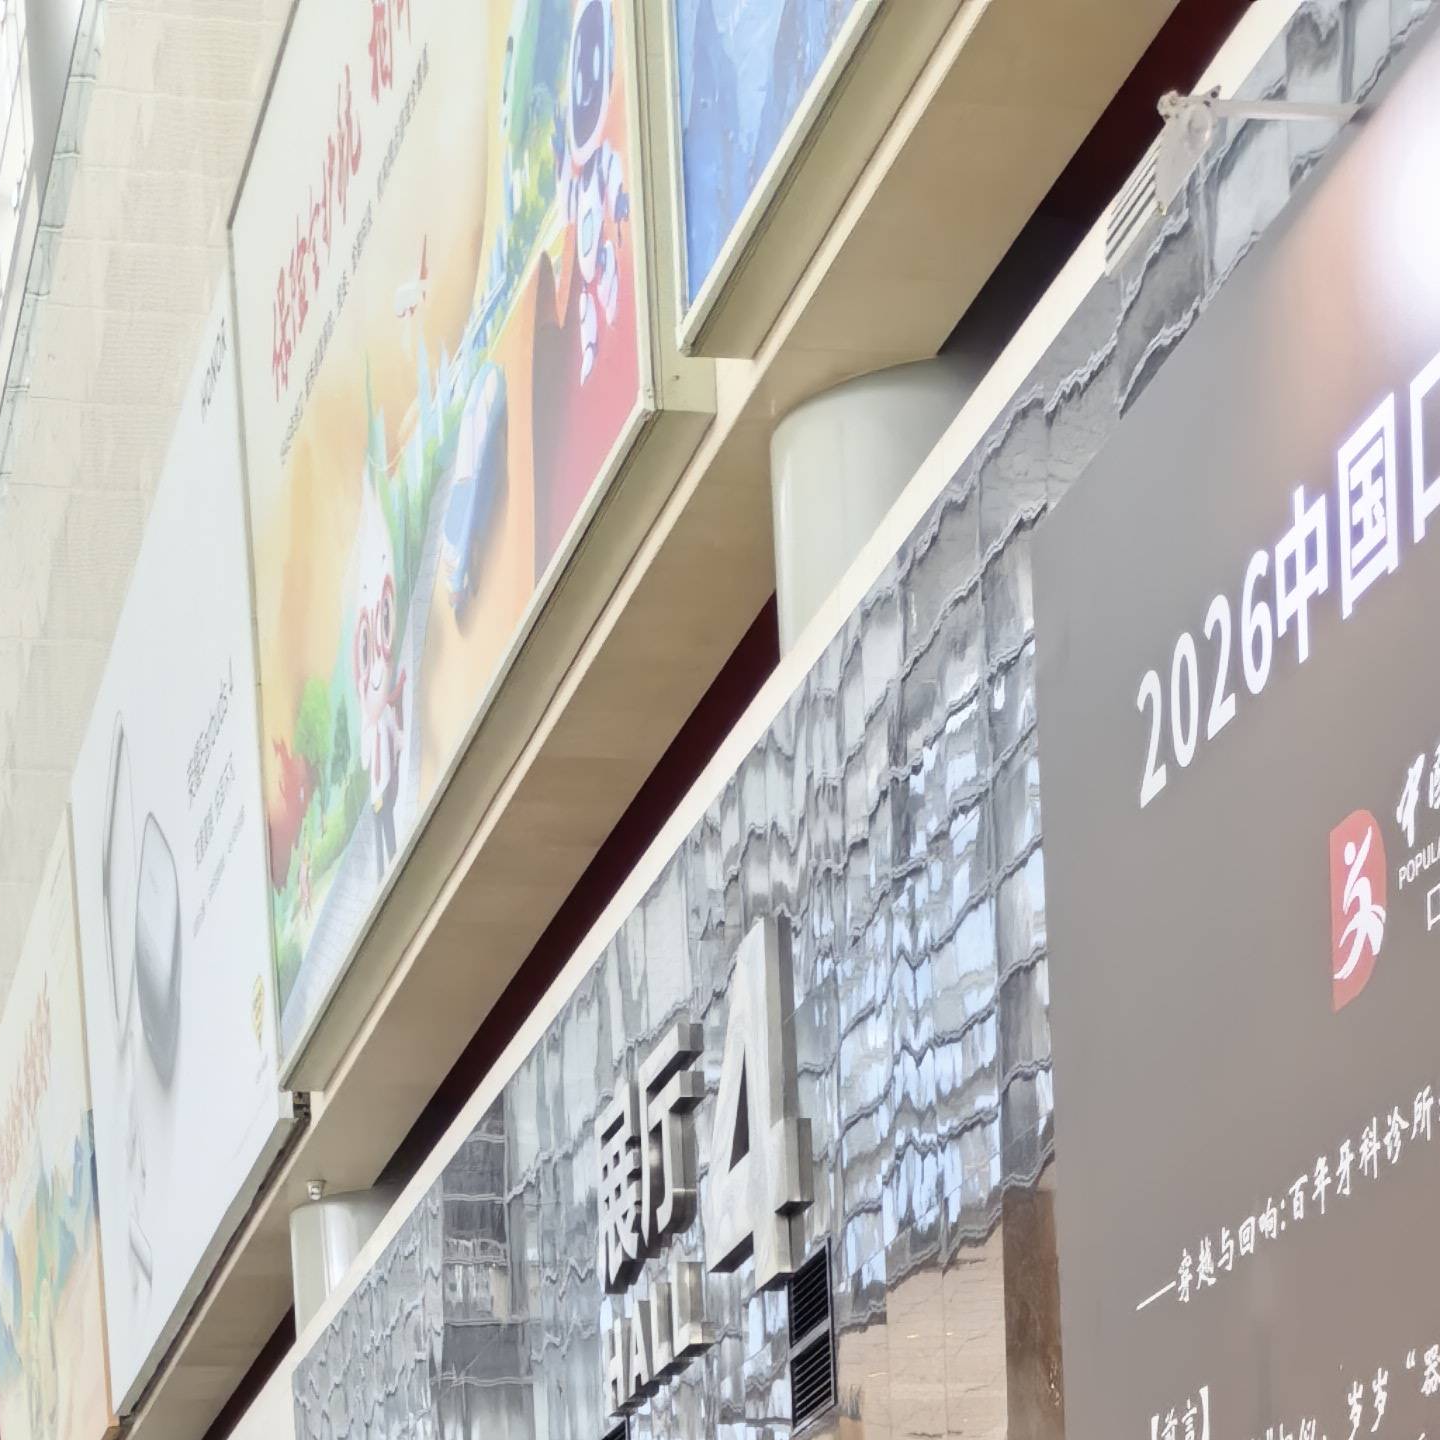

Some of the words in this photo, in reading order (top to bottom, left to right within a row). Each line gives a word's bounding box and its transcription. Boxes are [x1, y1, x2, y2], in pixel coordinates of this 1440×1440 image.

[596, 1020, 706, 1294] 展厅
[709, 913, 813, 1292] 4
[601, 1260, 716, 1416] HALL
